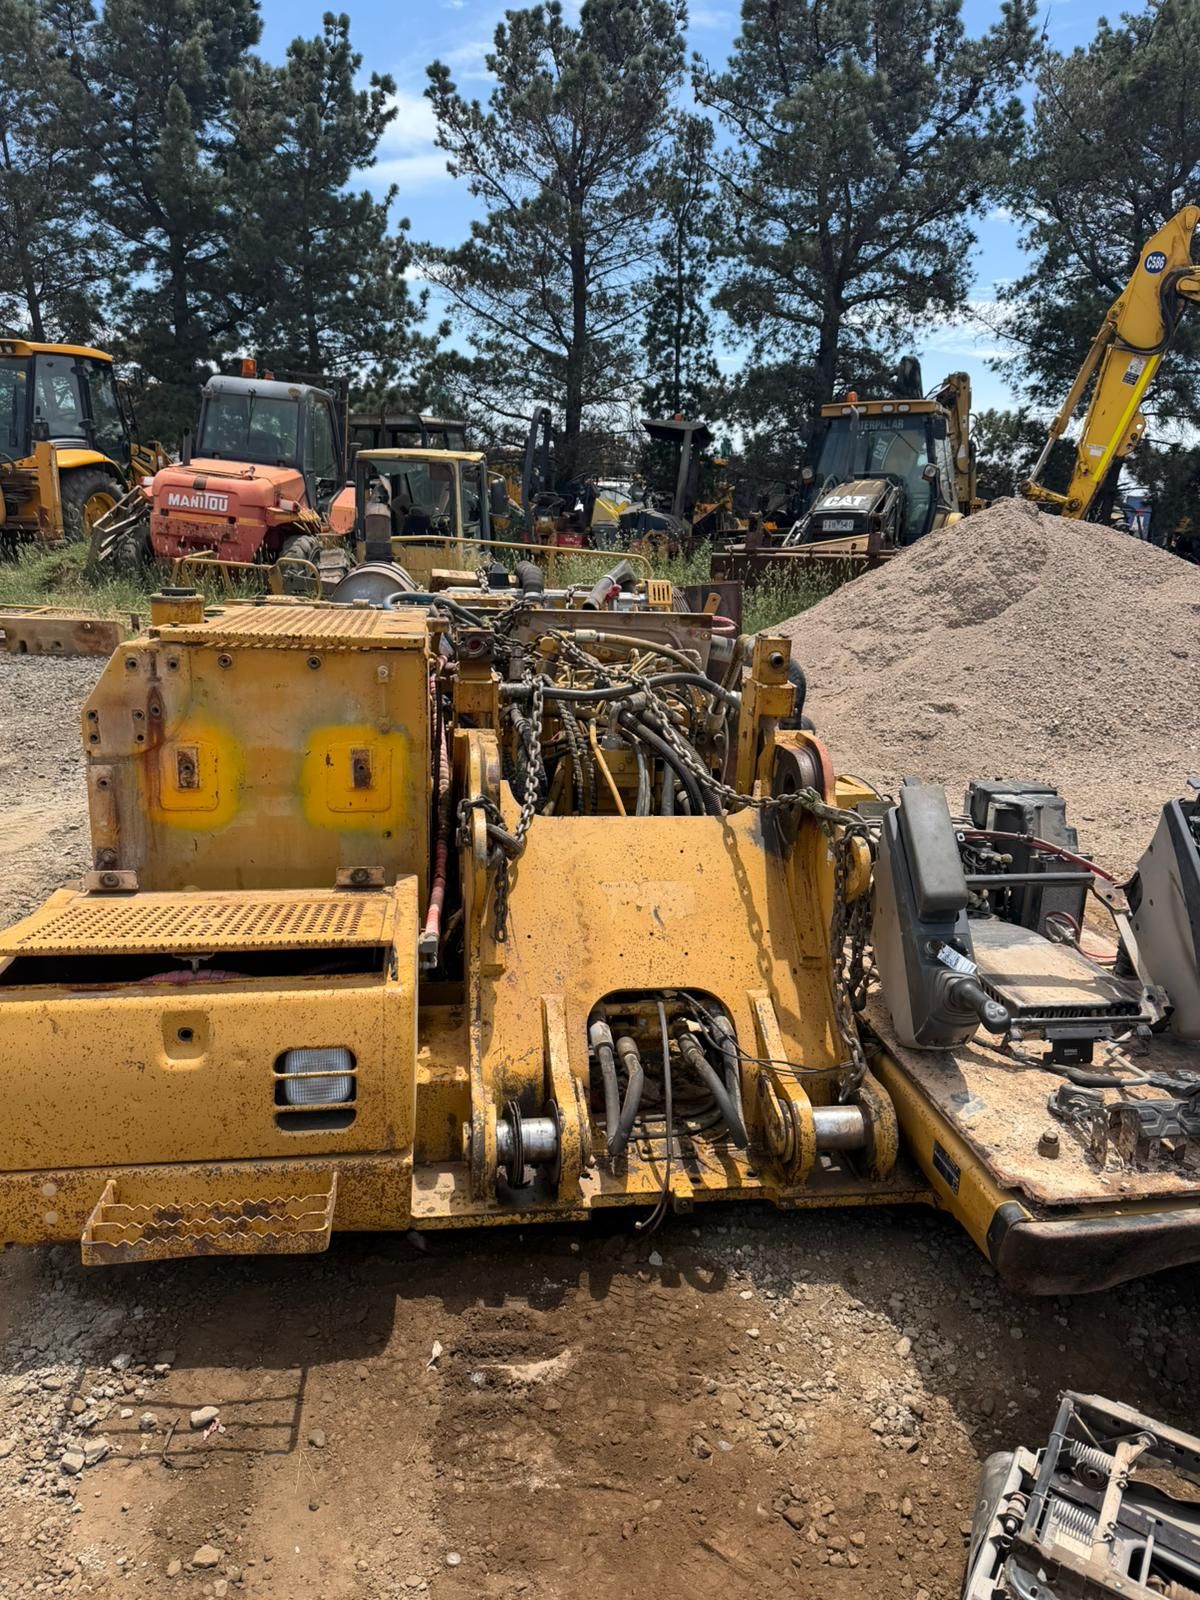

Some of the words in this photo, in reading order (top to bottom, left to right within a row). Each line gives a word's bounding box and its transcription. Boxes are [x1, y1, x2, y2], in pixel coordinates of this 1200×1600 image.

[1146, 255, 1166, 269] C586
[873, 437, 889, 460] CAT
[168, 492, 229, 512] MANITOU
[823, 494, 867, 507] CAT
